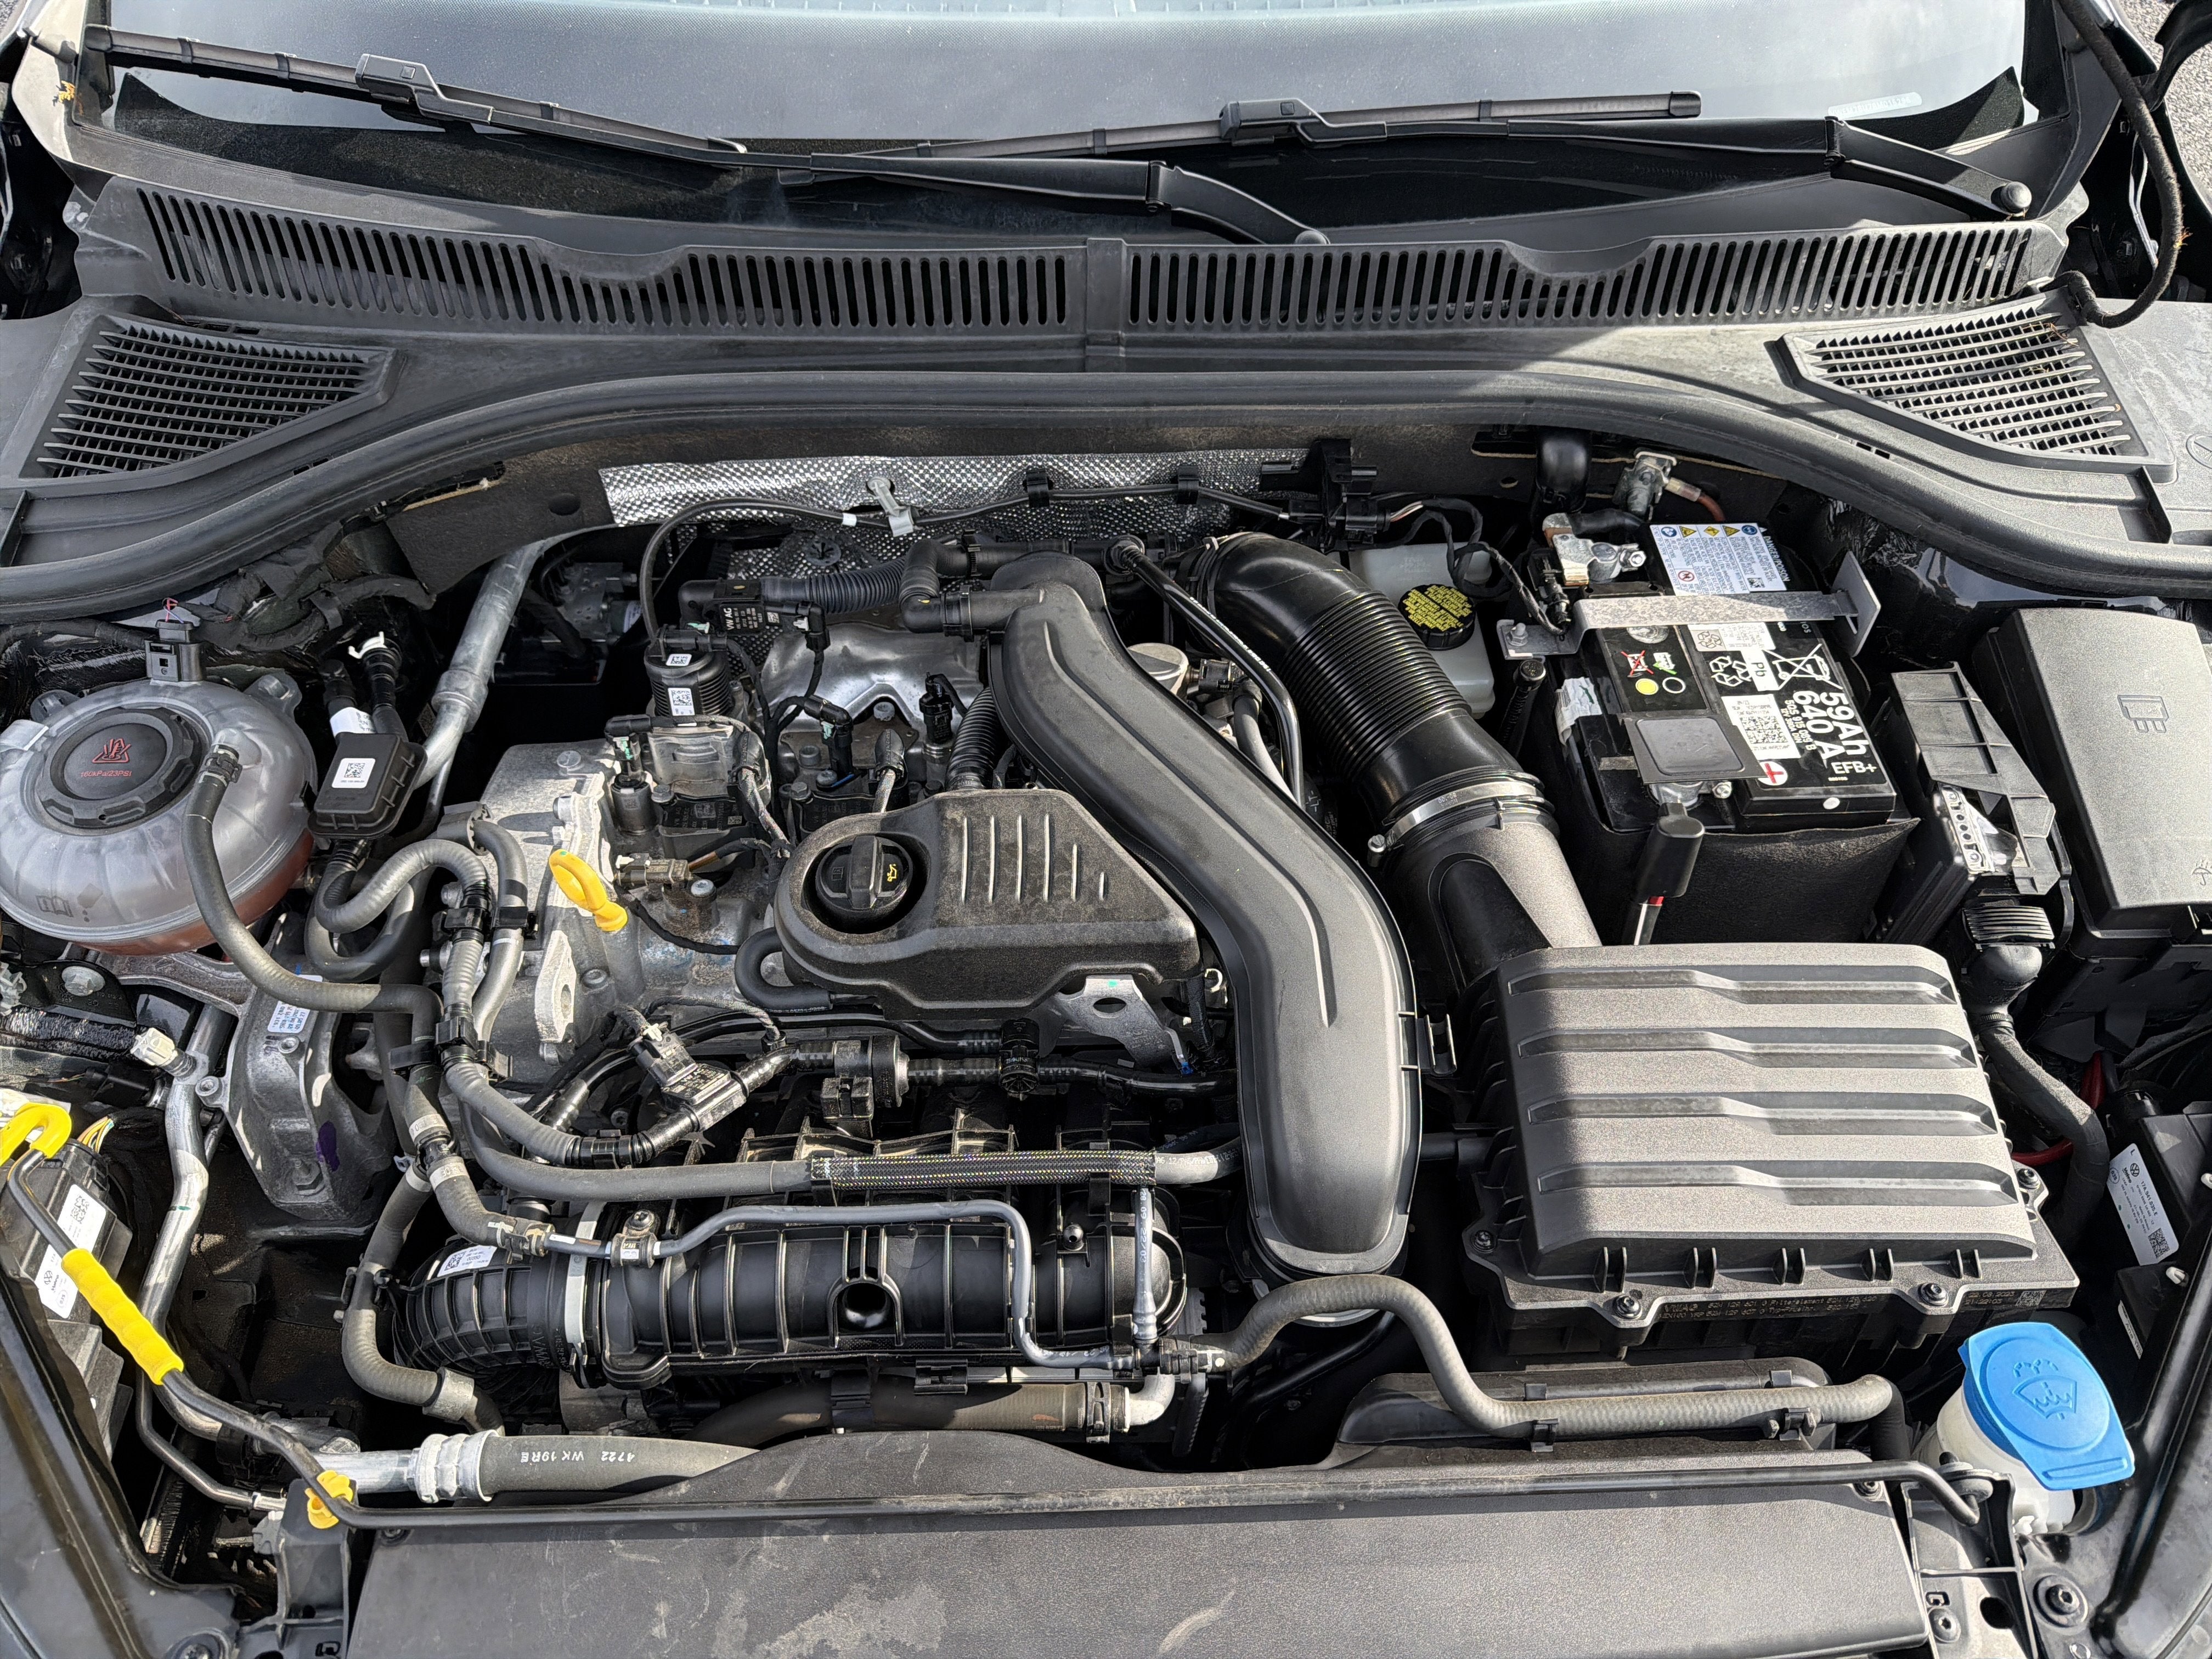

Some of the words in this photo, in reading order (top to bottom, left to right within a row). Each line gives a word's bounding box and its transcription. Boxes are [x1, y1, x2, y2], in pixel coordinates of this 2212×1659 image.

[1763, 535, 1791, 582] DANGER/POISON
[723, 607, 733, 618] AG
[725, 618, 735, 630] VW
[1751, 662, 1767, 676] Pb
[1792, 691, 1835, 735] 640
[1814, 741, 1846, 761] A
[1819, 691, 1869, 756] 59Ah
[1831, 759, 1878, 776] EFB+
[561, 1449, 584, 1462] WK
[600, 1450, 635, 1463] 4722
